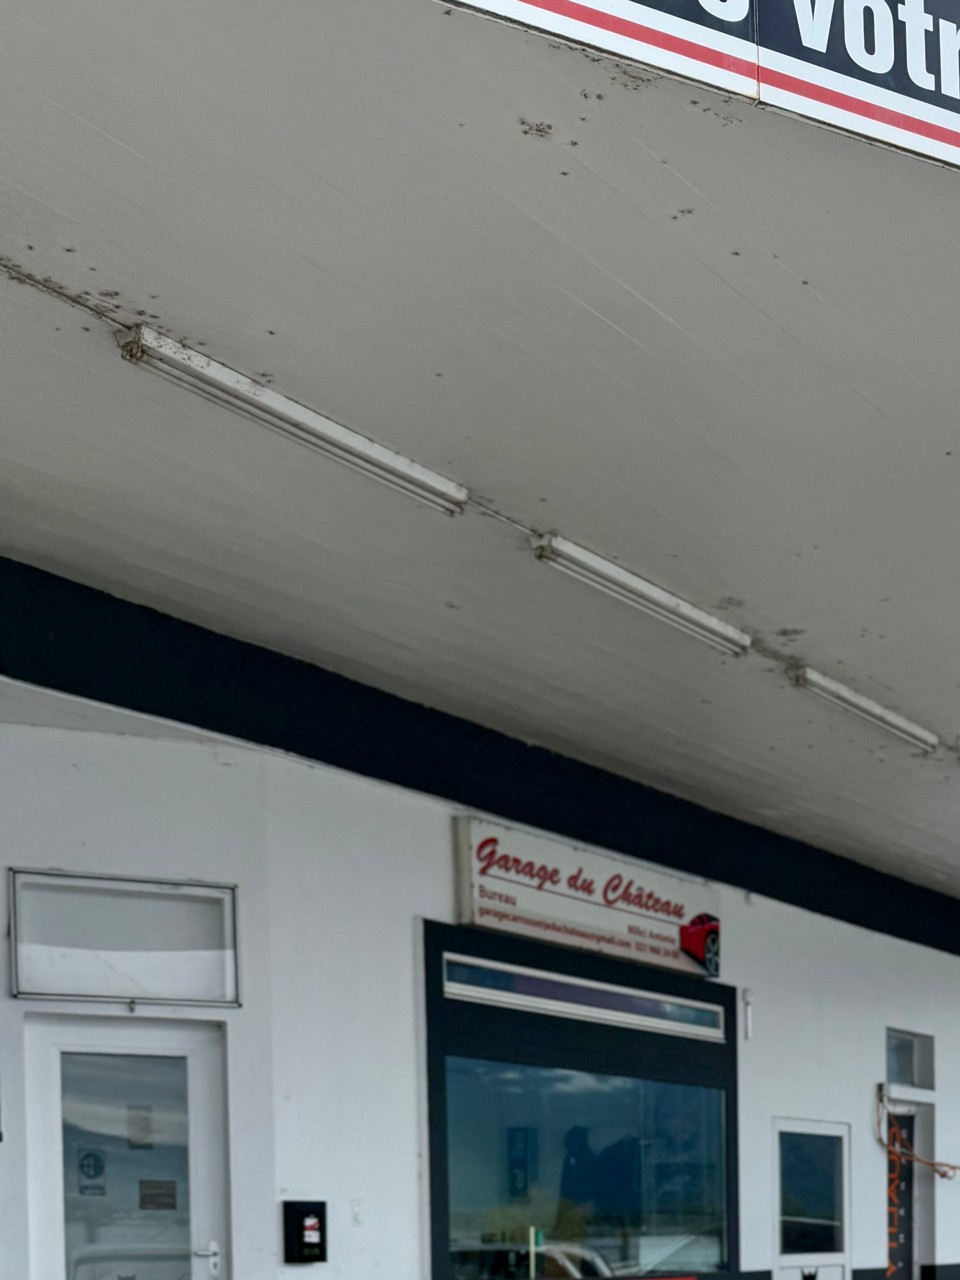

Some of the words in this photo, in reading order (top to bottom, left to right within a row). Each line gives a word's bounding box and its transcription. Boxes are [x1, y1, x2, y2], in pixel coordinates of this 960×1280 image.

[476, 837, 561, 890] Garage
[567, 868, 595, 896] du
[602, 873, 685, 919] Château
[478, 885, 517, 906] Bureau
